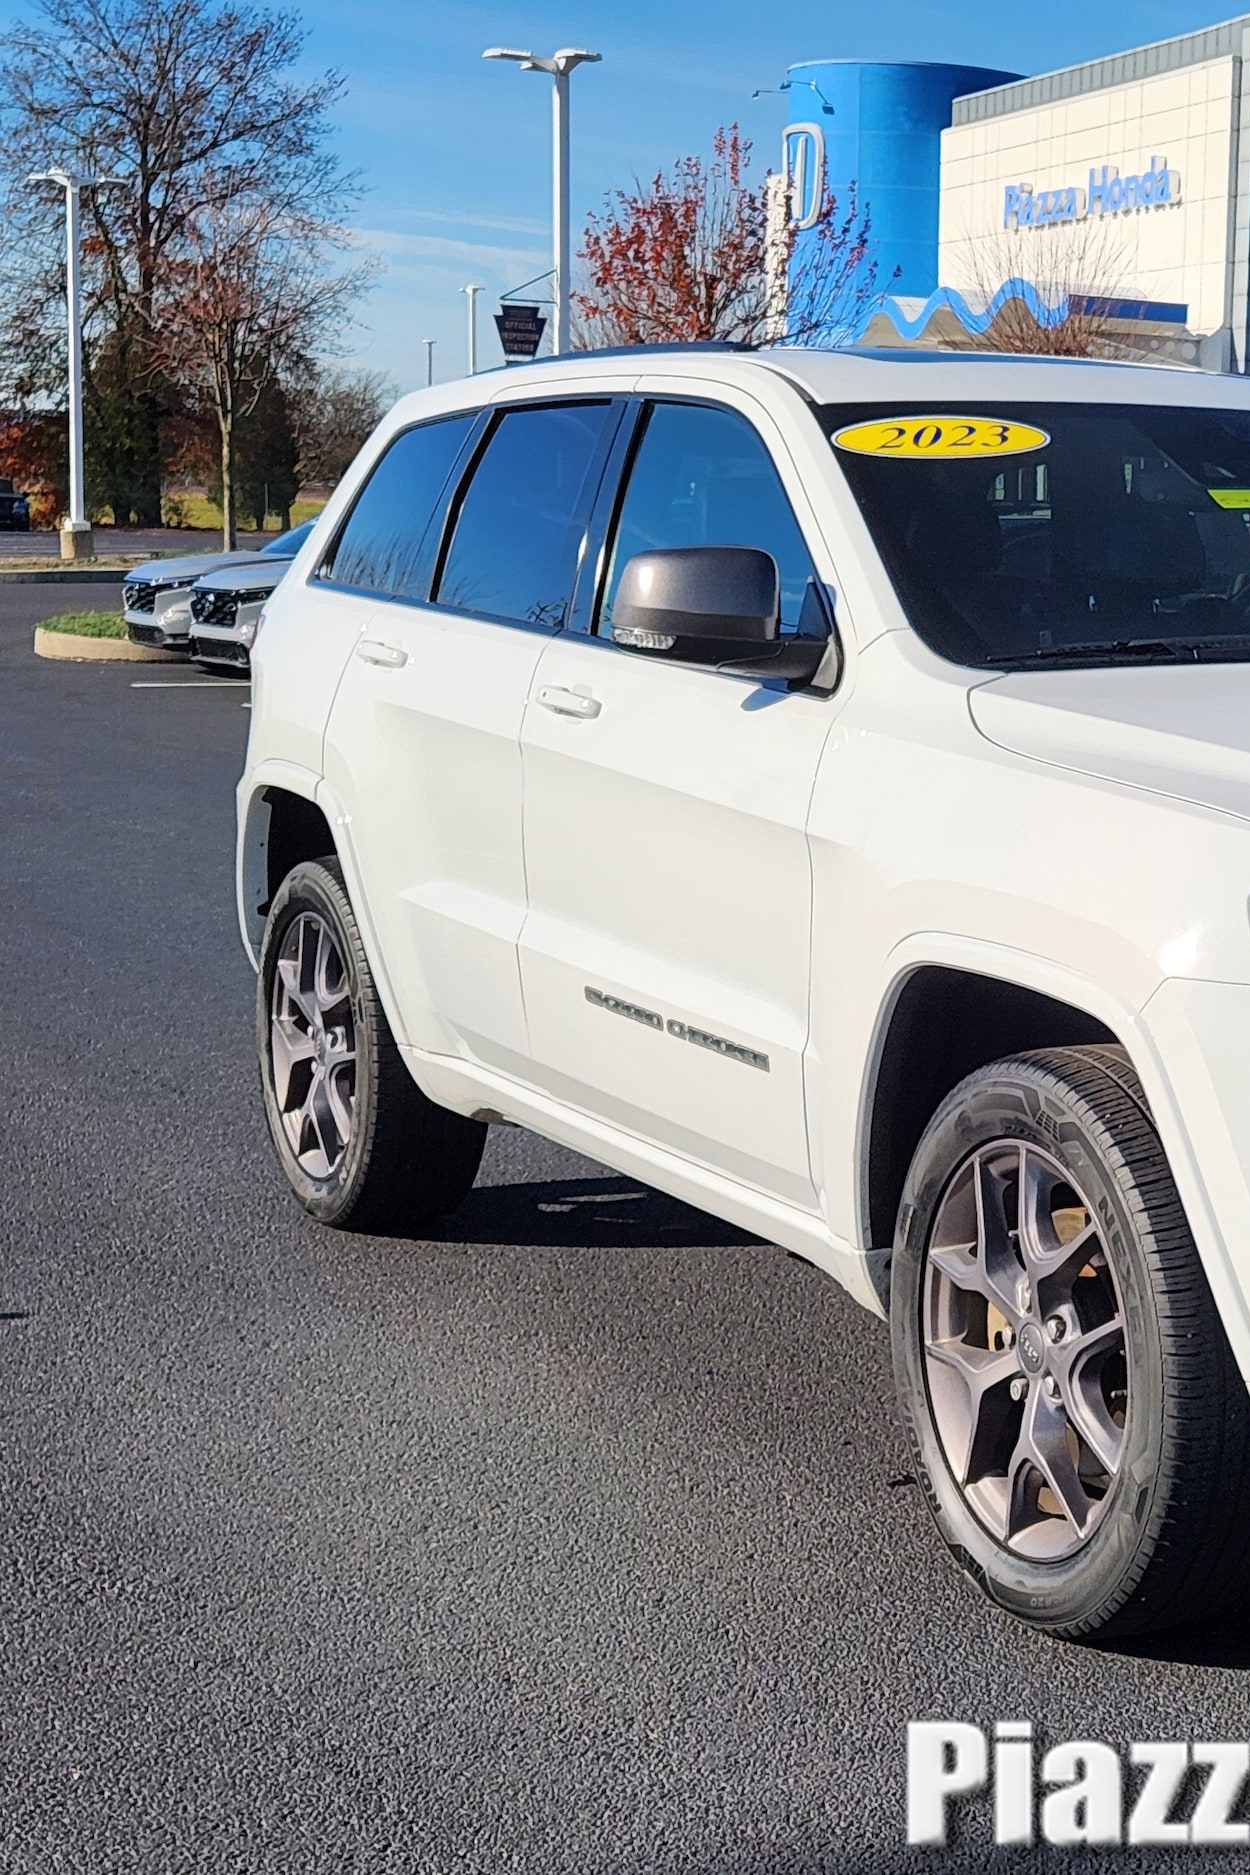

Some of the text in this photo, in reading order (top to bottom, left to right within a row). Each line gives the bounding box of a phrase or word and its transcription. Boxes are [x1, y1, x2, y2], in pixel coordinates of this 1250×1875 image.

[1004, 155, 1172, 229] Piazza Honda
[876, 425, 1011, 450] 2023
